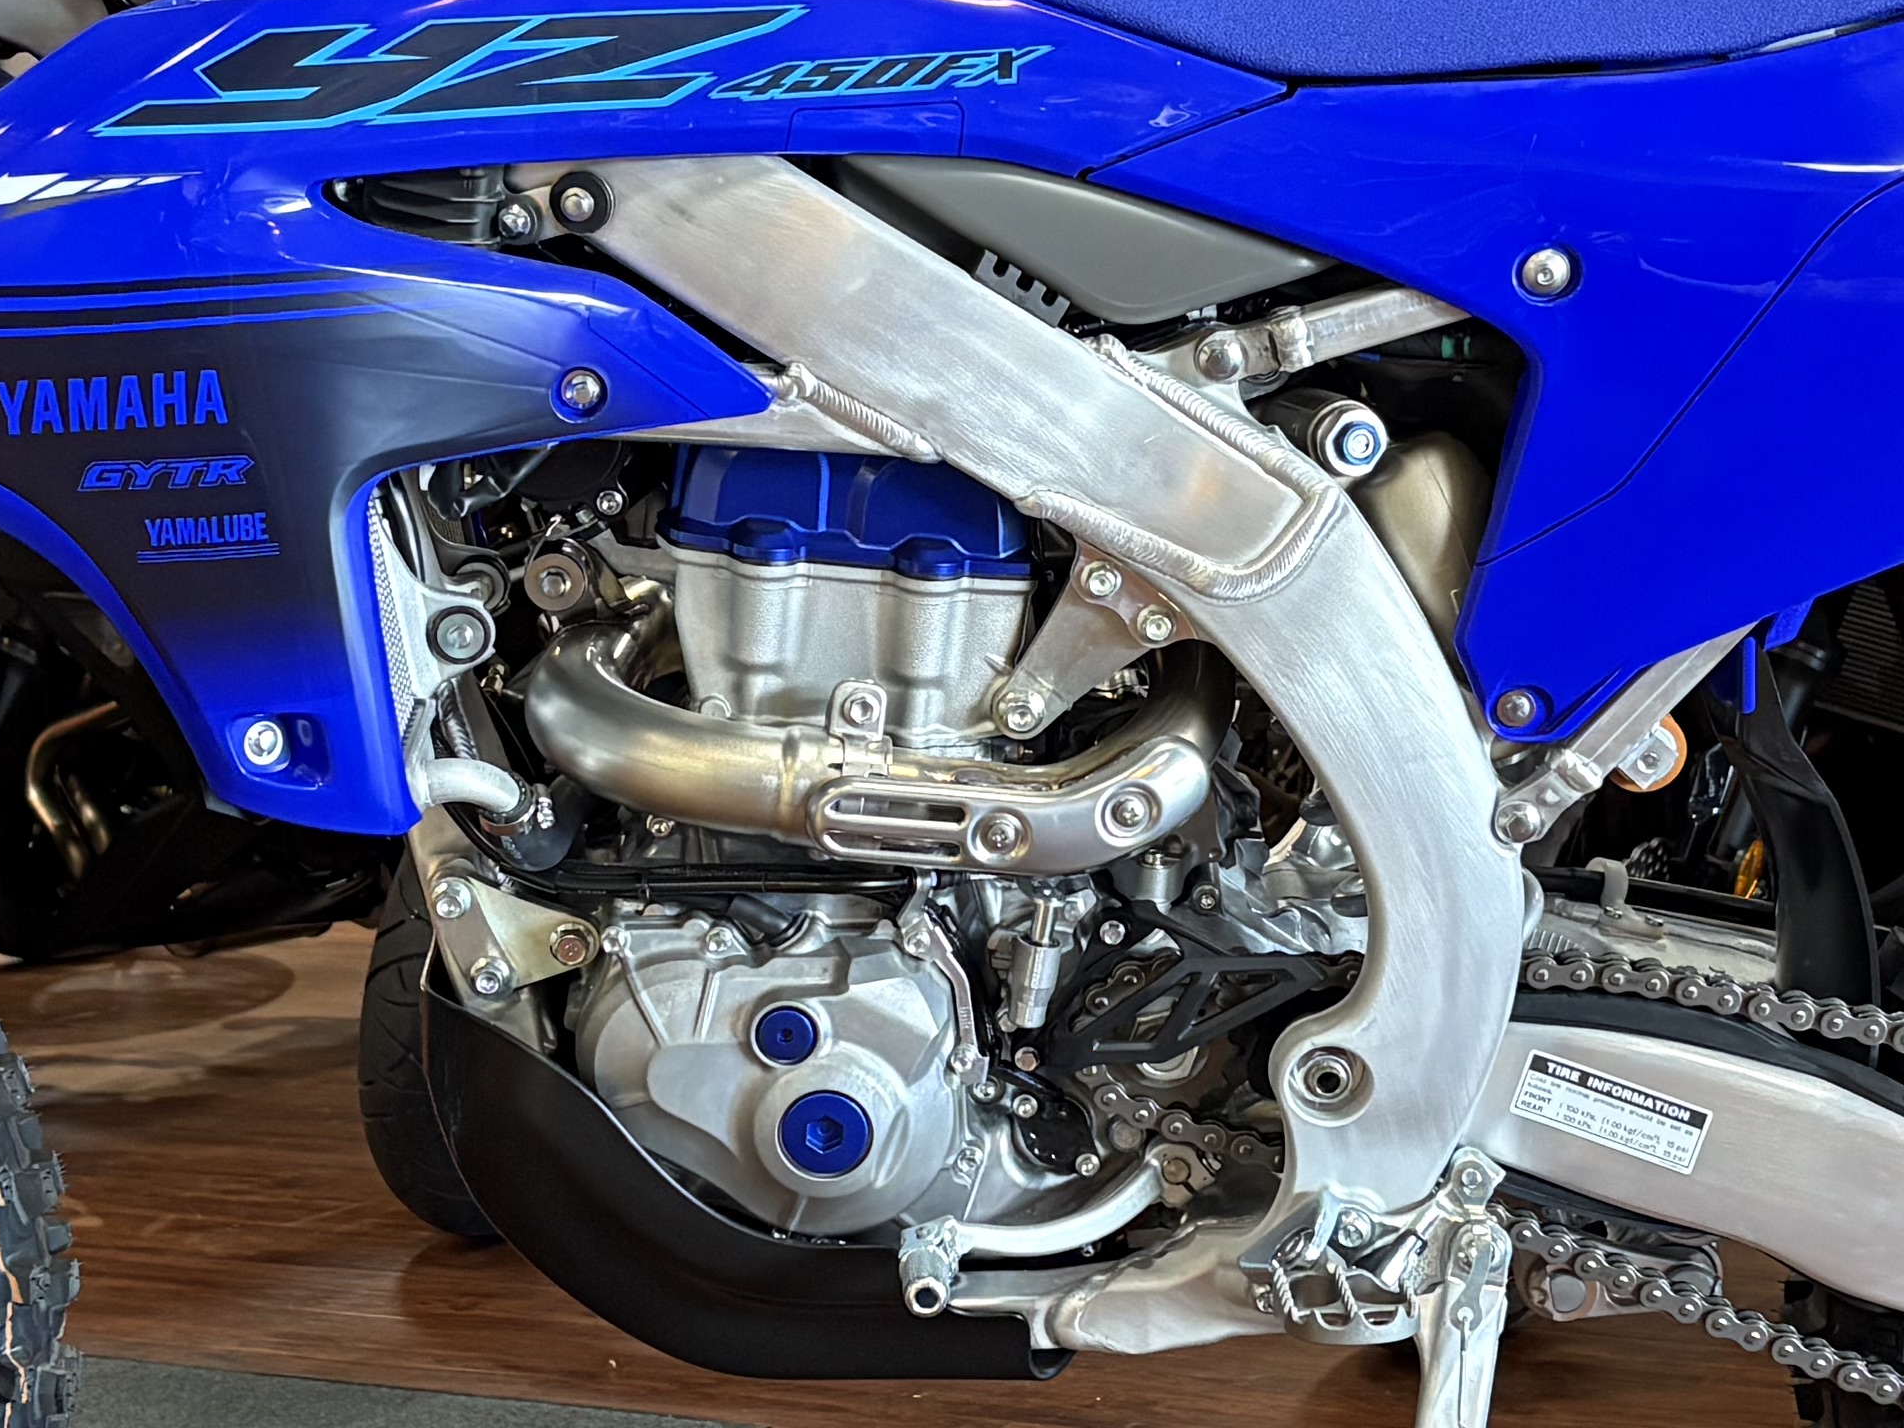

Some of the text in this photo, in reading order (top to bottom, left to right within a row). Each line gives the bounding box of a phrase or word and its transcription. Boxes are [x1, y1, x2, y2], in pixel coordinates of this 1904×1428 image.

[90, 4, 1054, 136] YZ 450FX
[76, 454, 255, 492] GYTR
[144, 512, 269, 547] YAMALUBE
[1520, 1100, 1544, 1113] REAR
[1523, 1091, 1552, 1106] FRONT
[1546, 1061, 1691, 1122] TIRE INFORMATION
